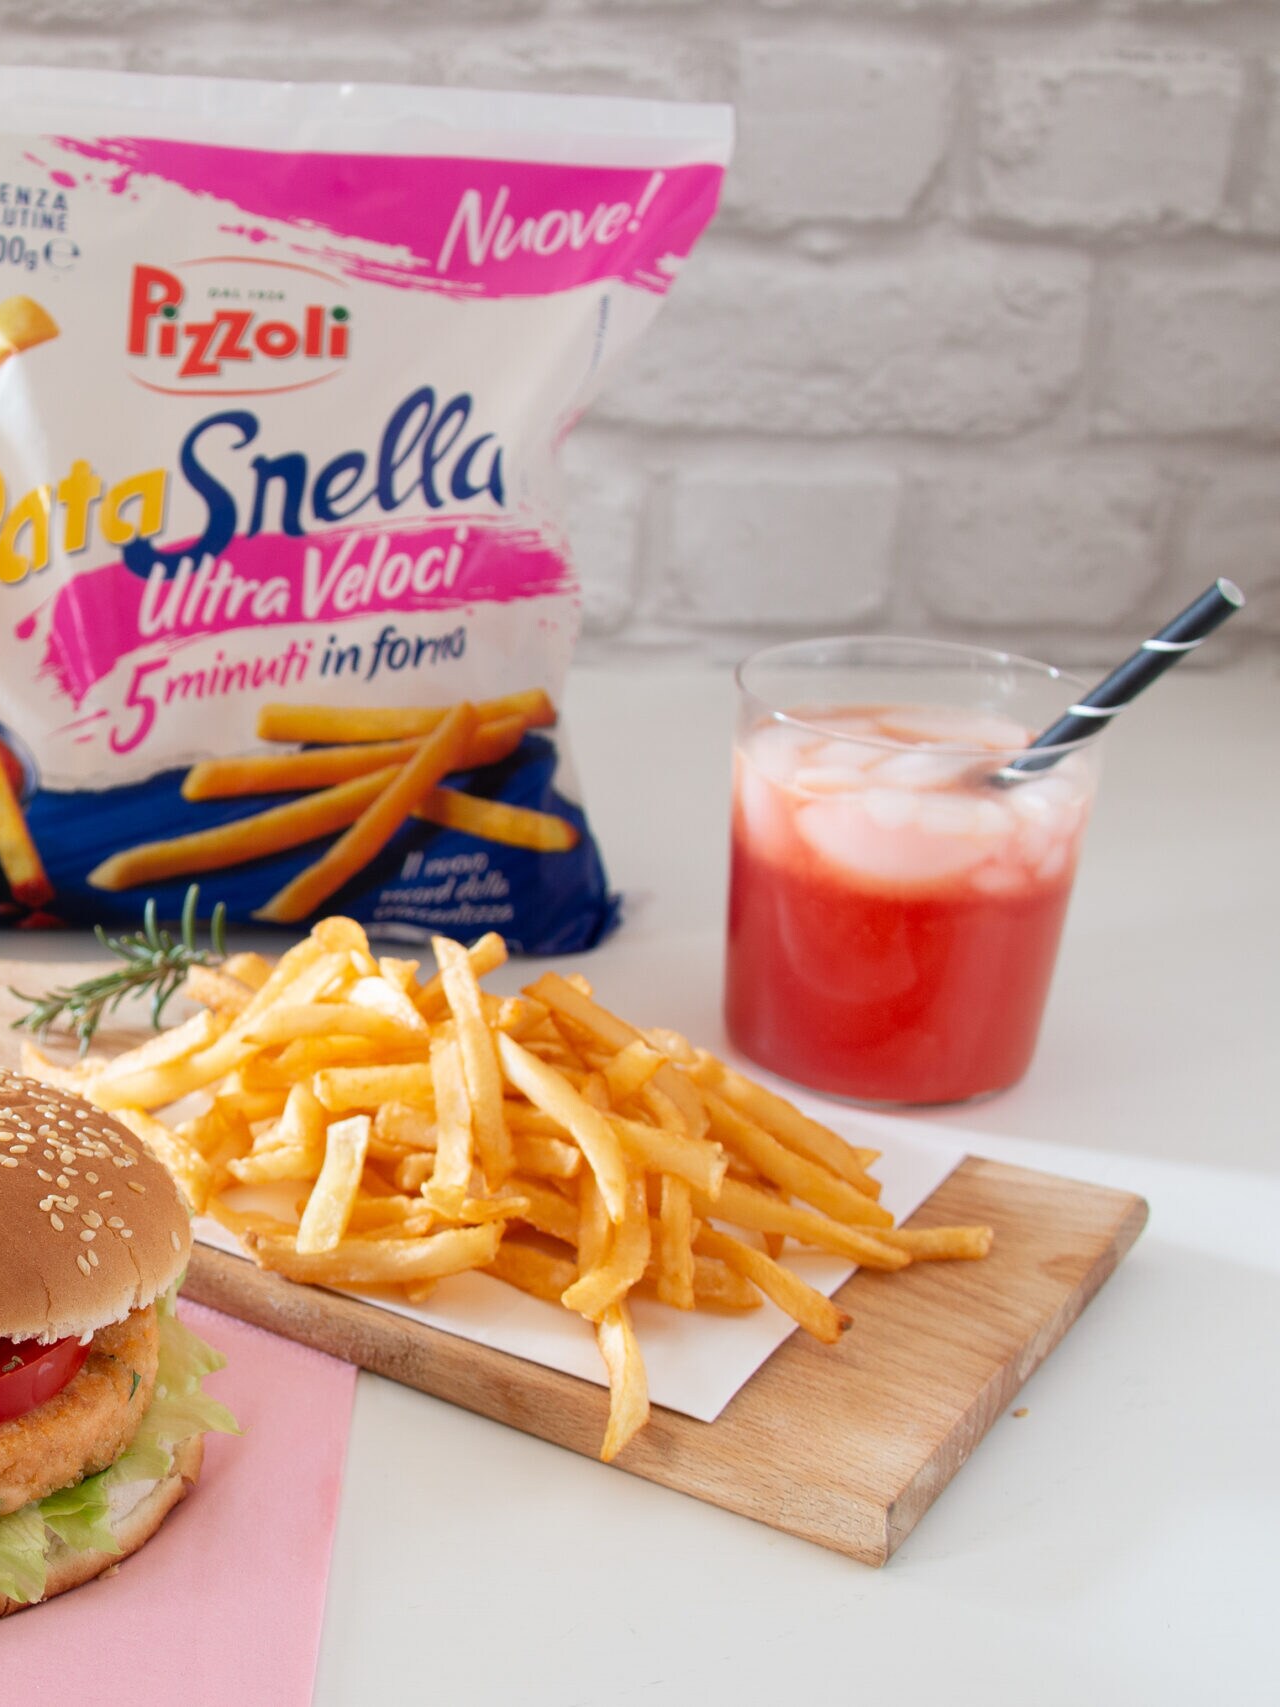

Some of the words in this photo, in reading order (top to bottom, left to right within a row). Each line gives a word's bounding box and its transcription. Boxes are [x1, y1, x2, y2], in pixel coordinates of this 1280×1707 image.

[437, 170, 665, 273] Nuove!
[127, 264, 350, 378] Pizzoli
[138, 552, 290, 637] Ultra
[301, 528, 465, 620] Veloci
[109, 656, 169, 754] 5
[163, 640, 314, 705] minuti
[320, 635, 361, 676] in
